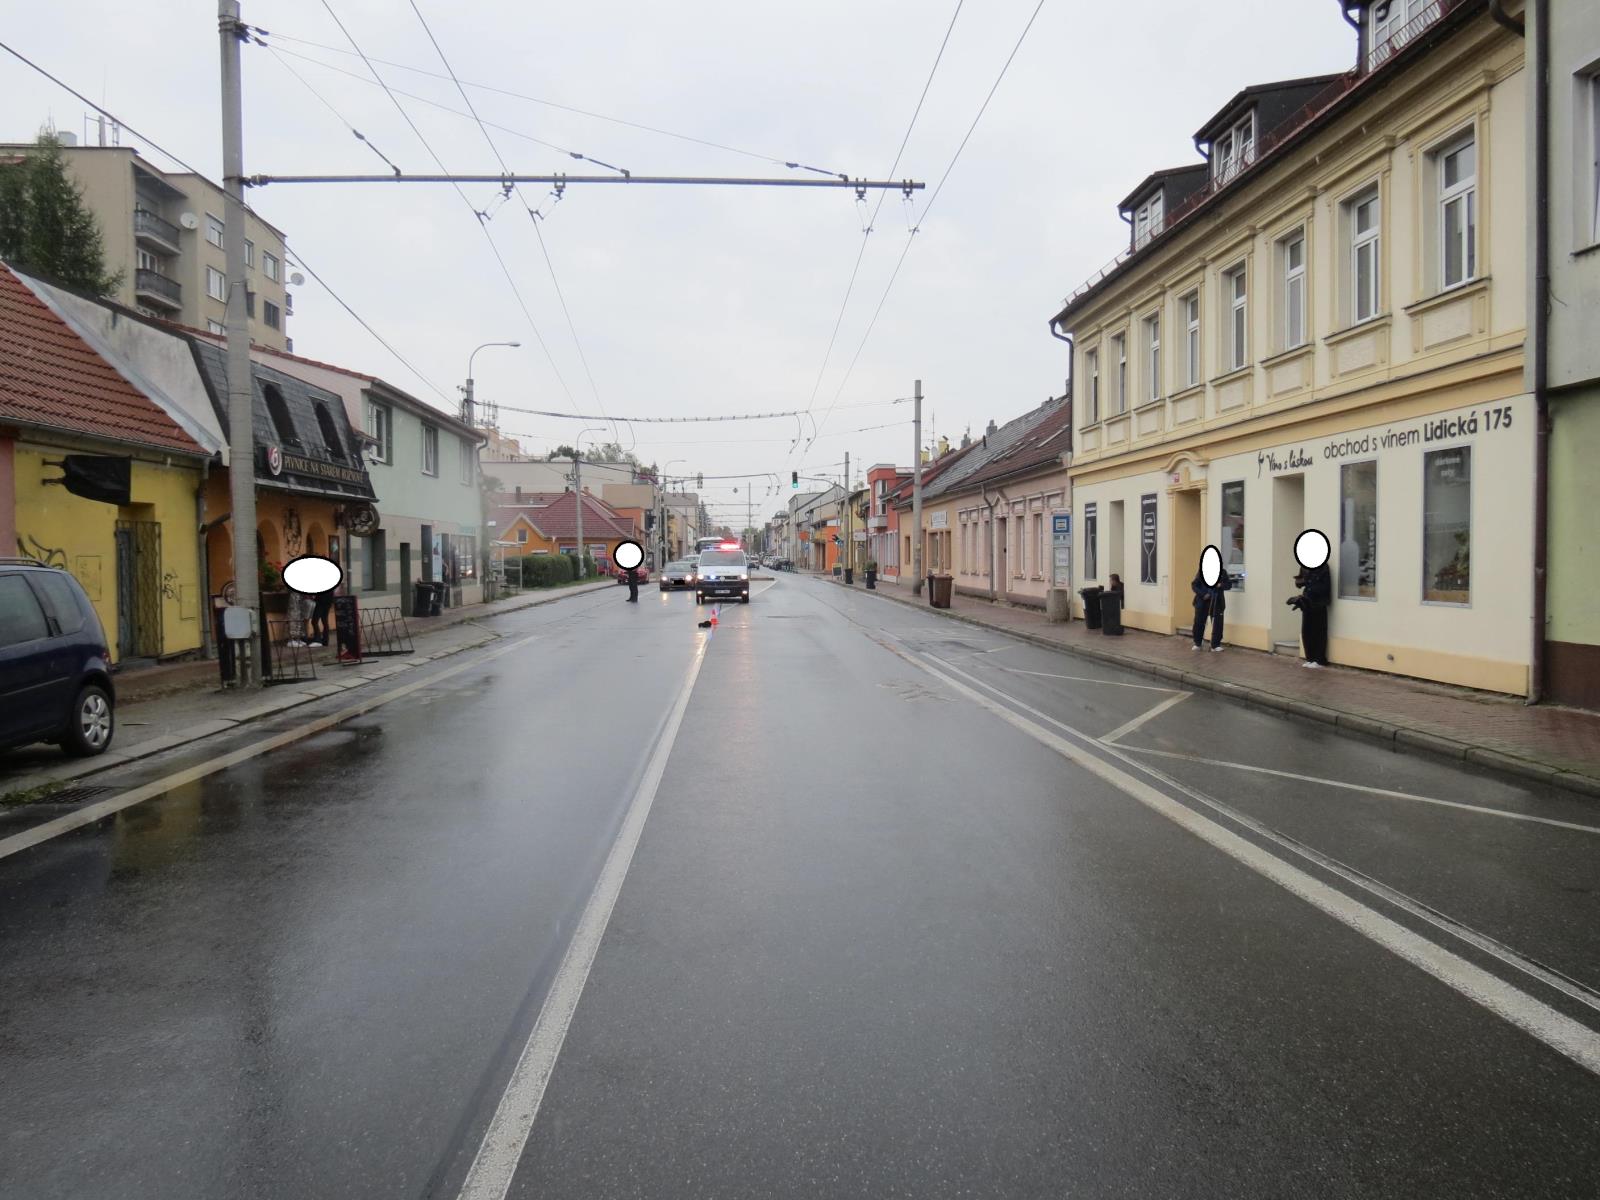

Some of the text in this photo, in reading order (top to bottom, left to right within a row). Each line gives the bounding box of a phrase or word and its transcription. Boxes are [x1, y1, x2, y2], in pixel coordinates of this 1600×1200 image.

[1323, 406, 1512, 459] obchod s vínem Lidická 175
[284, 455, 308, 473] PIVNICE
[310, 461, 320, 475] NA
